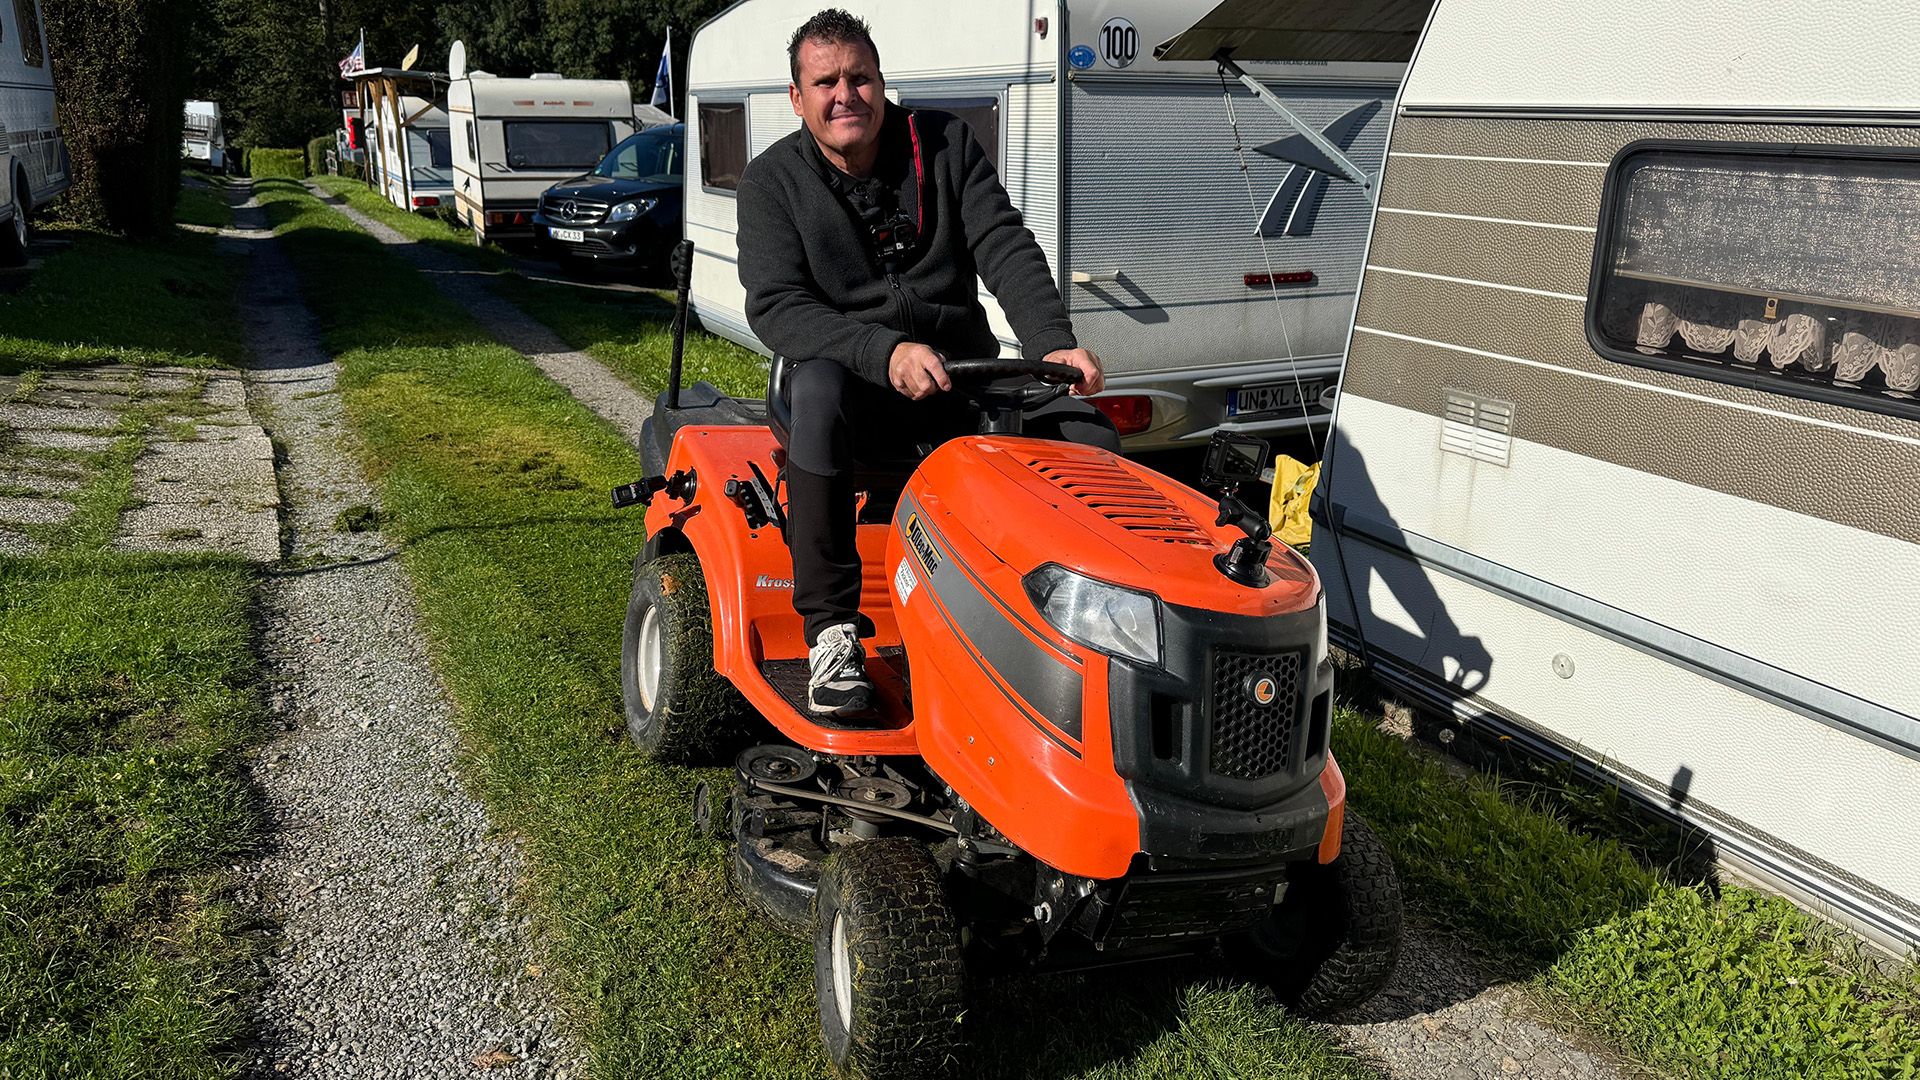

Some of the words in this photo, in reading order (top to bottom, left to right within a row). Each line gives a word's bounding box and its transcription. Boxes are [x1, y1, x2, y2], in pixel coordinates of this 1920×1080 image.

[1103, 25, 1136, 60] 100
[573, 231, 581, 240] 33
[1239, 390, 1260, 411] UN
[1269, 387, 1290, 408] XL
